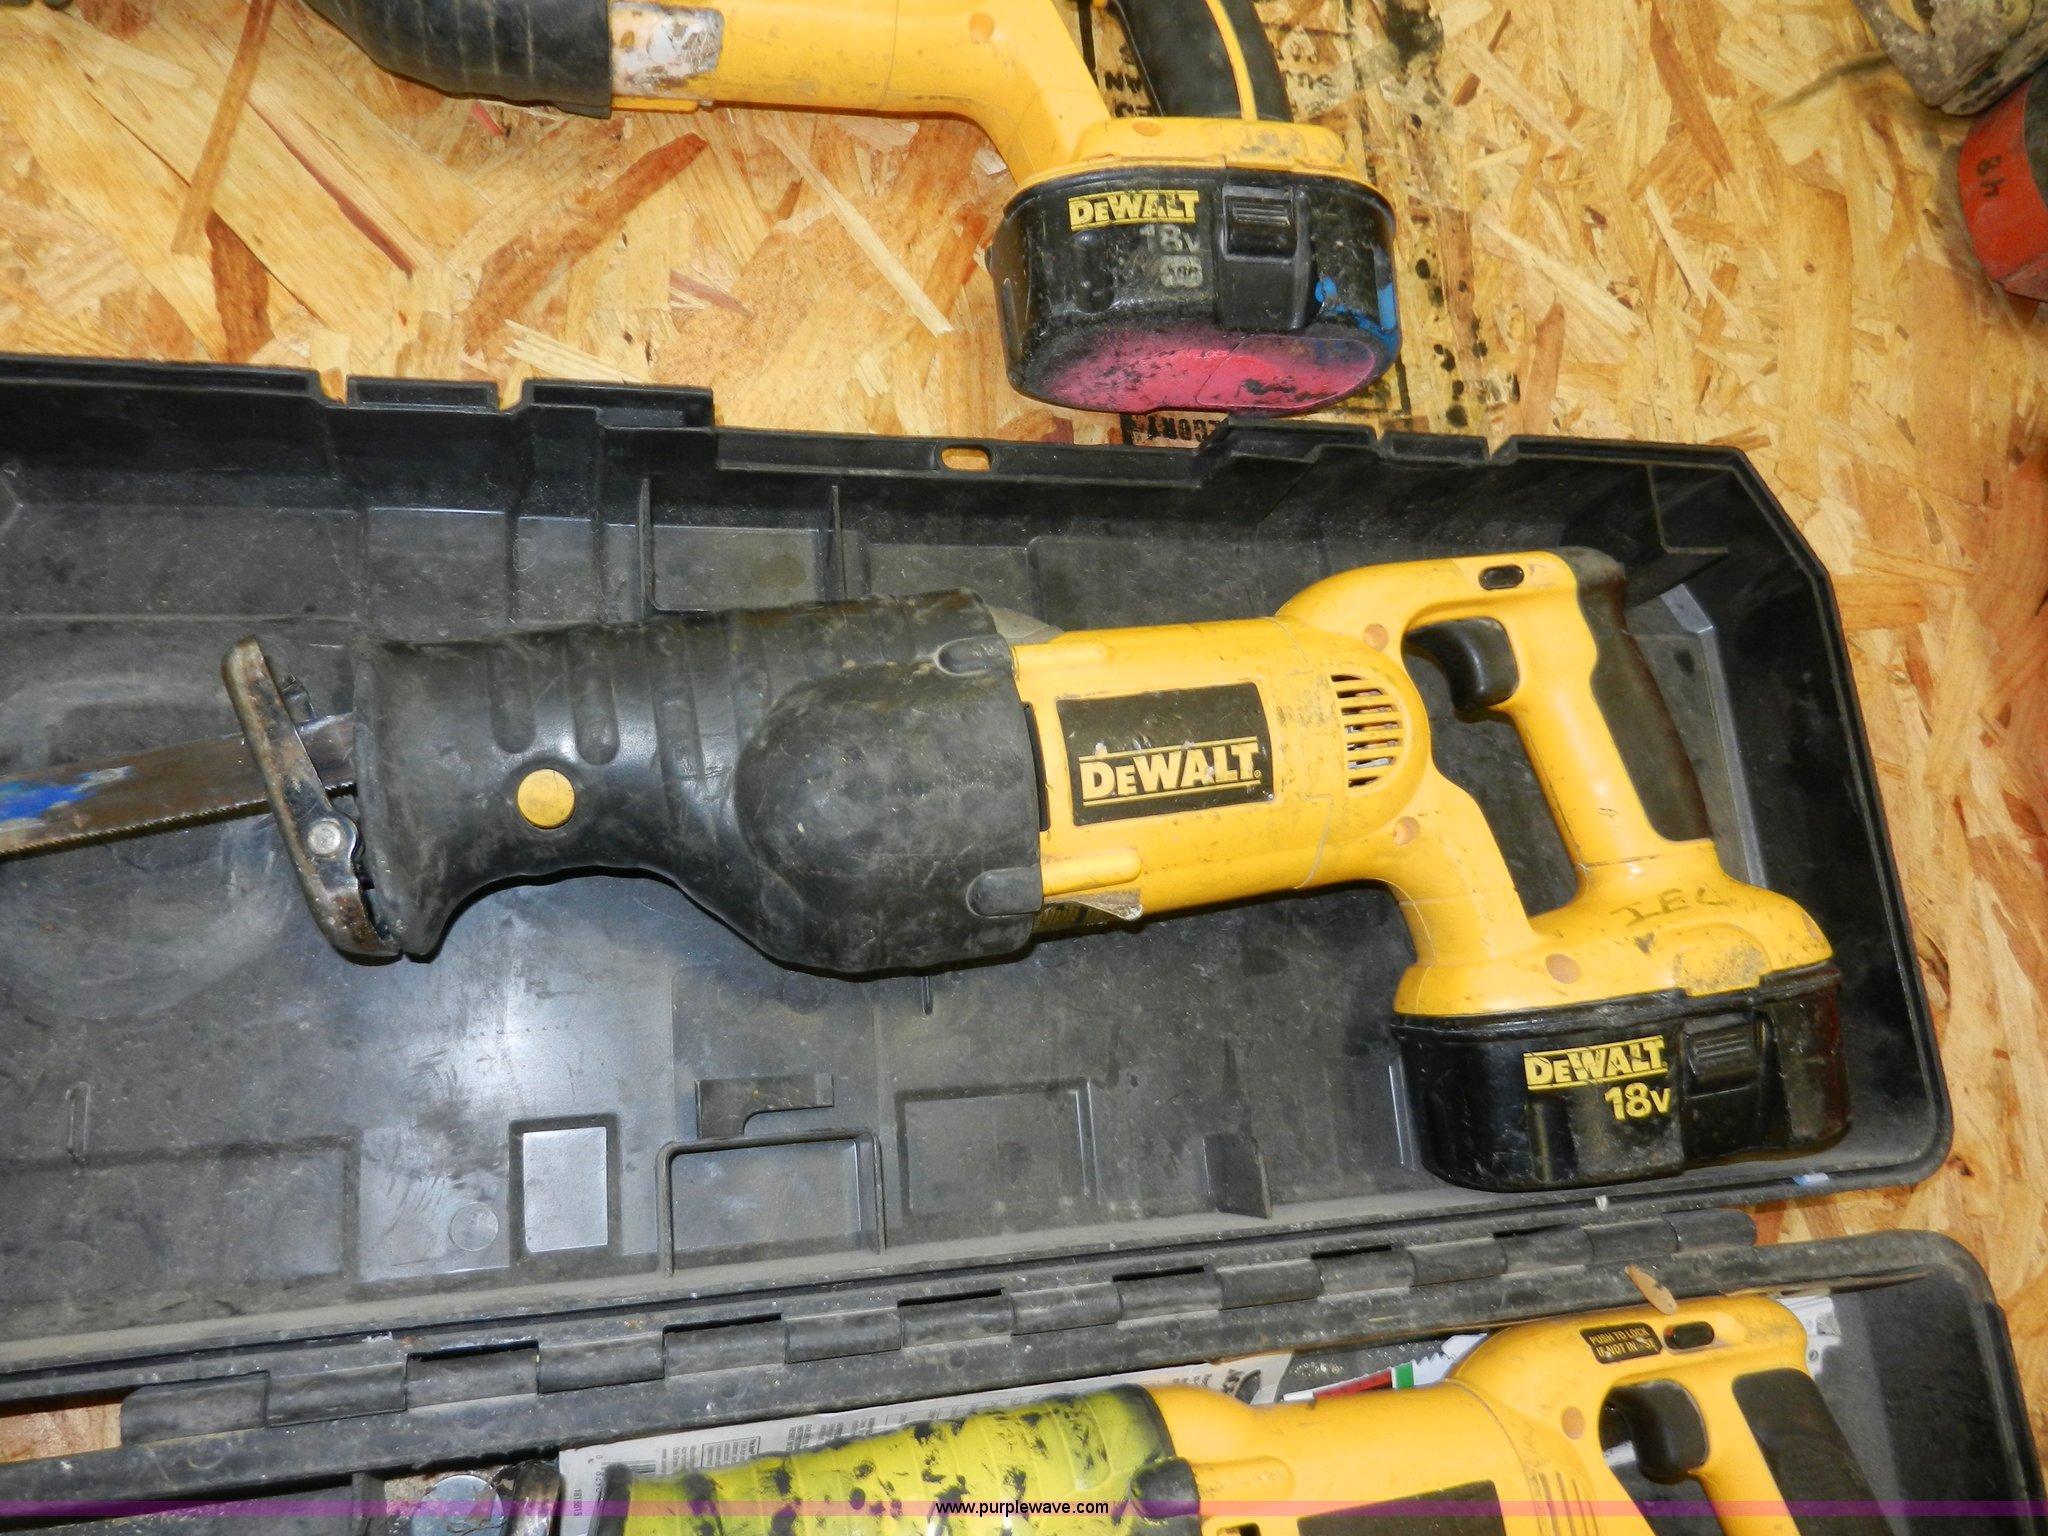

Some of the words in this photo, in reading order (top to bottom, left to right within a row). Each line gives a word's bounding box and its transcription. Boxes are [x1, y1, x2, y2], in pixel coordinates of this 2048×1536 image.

[1589, 1333, 1615, 1345] PUSH
[1614, 1330, 1626, 1340] TO
[1625, 1327, 1650, 1338] LOCK
[1605, 1342, 1627, 1356] NOT
[1625, 1341, 1639, 1352] IN
